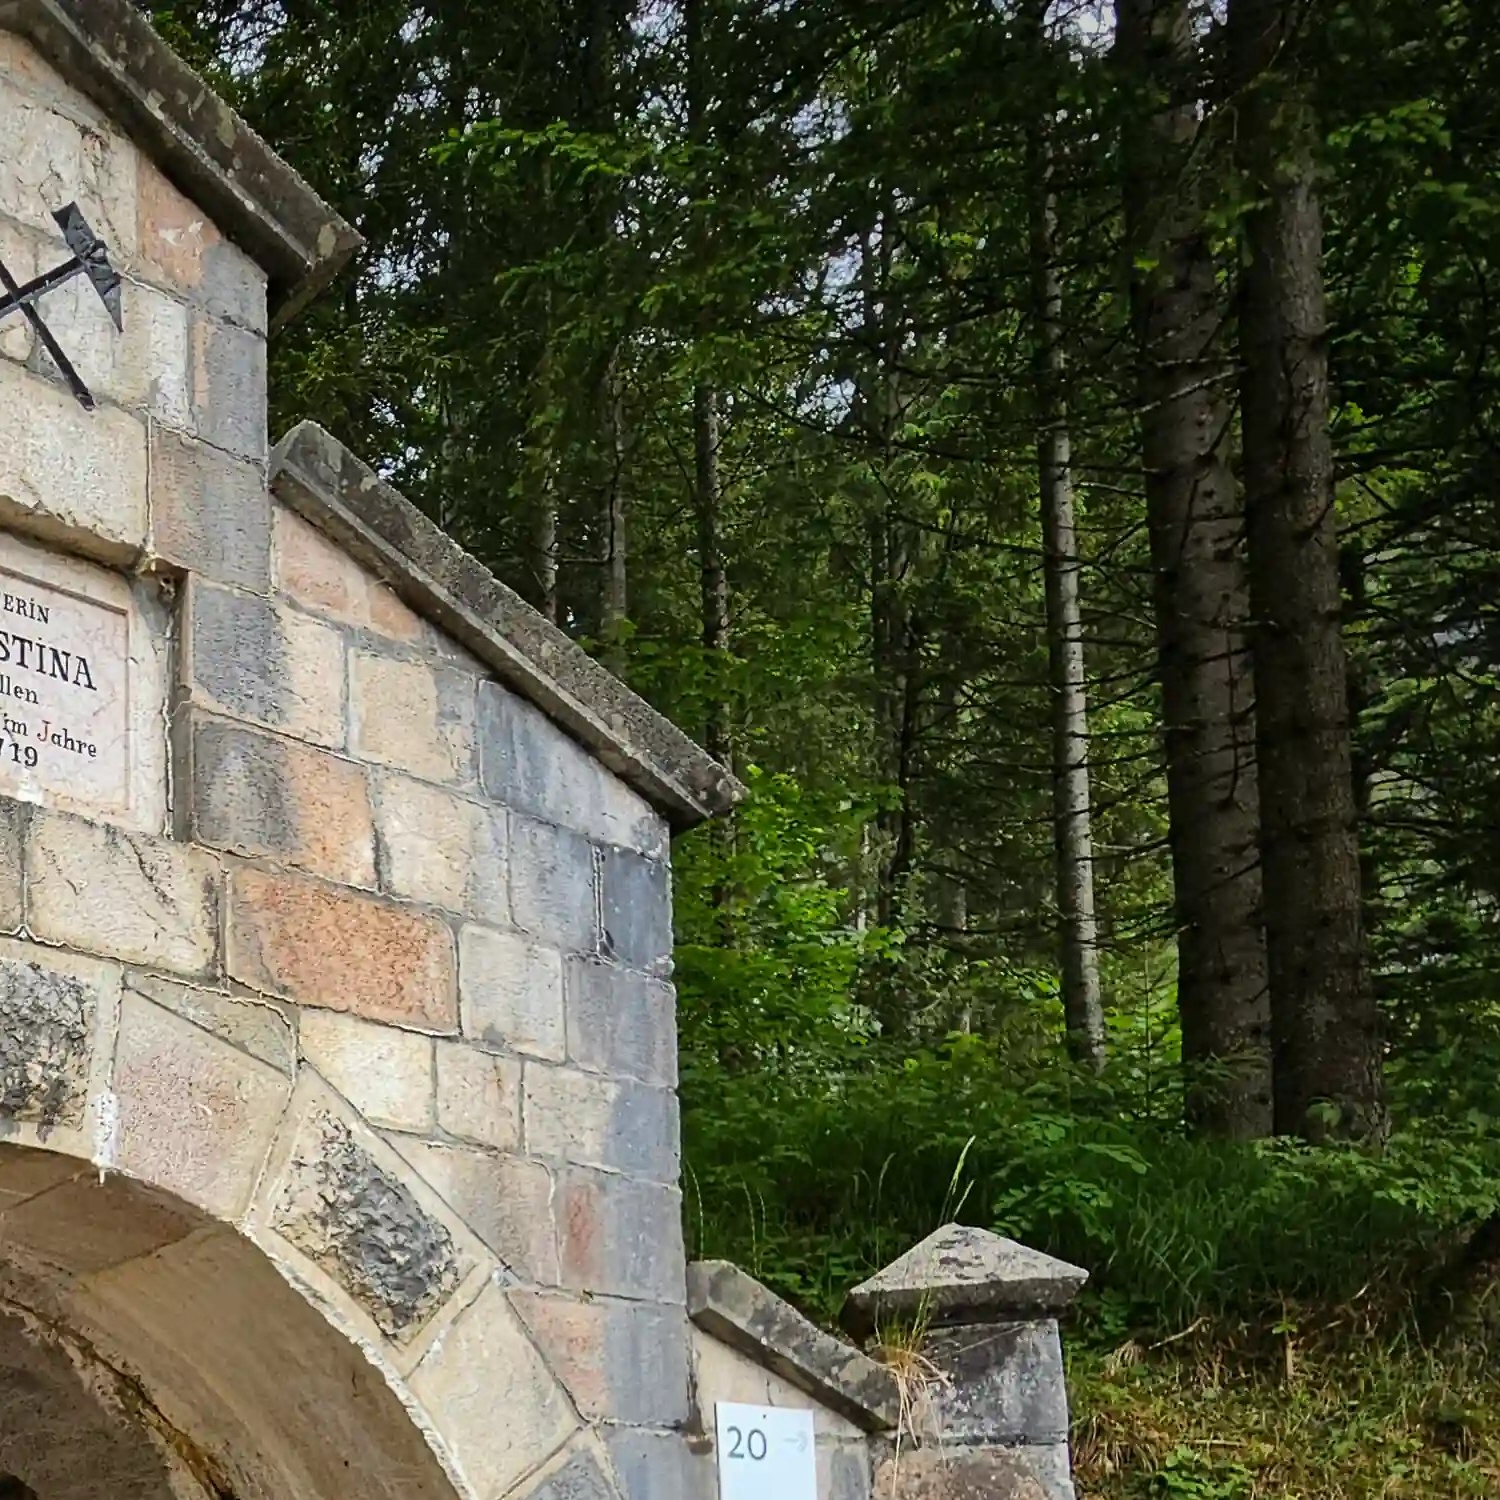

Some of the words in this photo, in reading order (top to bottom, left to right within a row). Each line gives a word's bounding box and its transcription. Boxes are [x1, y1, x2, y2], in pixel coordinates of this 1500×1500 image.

[2, 713, 28, 737] im
[36, 719, 97, 758] Jahre
[727, 1426, 767, 1460] 20
